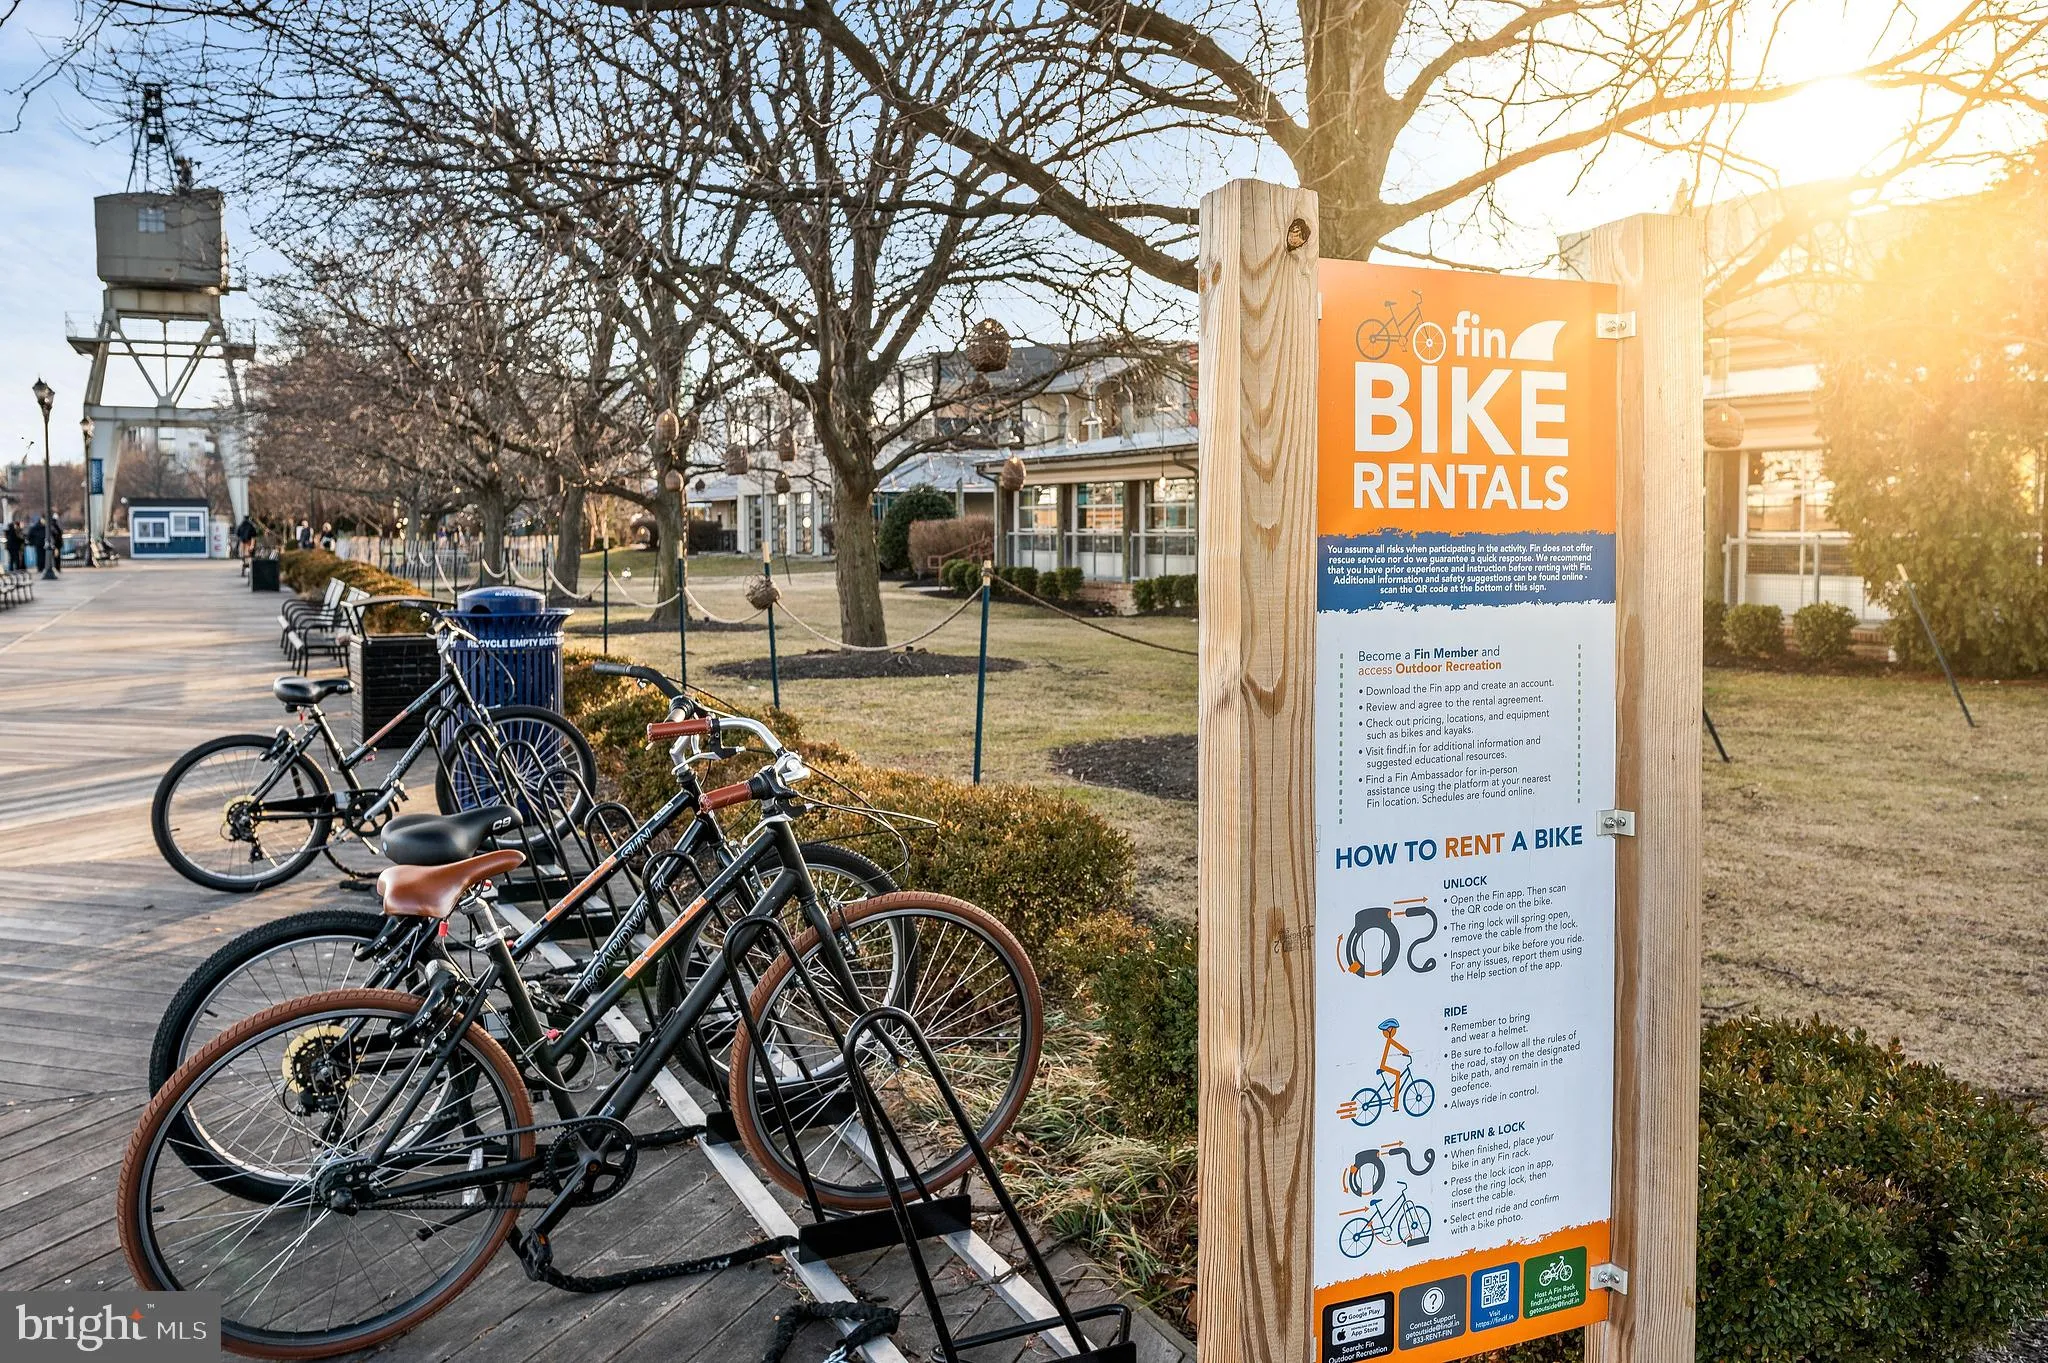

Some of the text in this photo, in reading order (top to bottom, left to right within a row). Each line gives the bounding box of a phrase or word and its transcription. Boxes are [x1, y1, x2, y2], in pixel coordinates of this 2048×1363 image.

[1452, 310, 1506, 358] fin
[1355, 361, 1568, 456] BIKE
[1353, 462, 1568, 511] RENTALS
[1327, 544, 1342, 553] You
[1375, 544, 1384, 552] all
[1386, 544, 1404, 552] risks
[1405, 544, 1427, 552] when
[1428, 543, 1475, 554] participating
[1477, 543, 1484, 552] in
[1485, 543, 1498, 552] the
[1500, 543, 1527, 554] activity.
[1529, 543, 1540, 552] Fin
[1542, 543, 1560, 551] does
[1561, 543, 1574, 551] not
[1575, 542, 1593, 551] offer
[1327, 561, 1592, 576] that you have prior experience and instruction before renting with Fin.
[1399, 584, 1412, 593] the
[1414, 584, 1427, 592] QR
[1429, 583, 1448, 592] code
[1450, 584, 1458, 592] at
[1459, 583, 1472, 592] the
[1474, 582, 1502, 591] bottom
[1504, 582, 1512, 591] of
[1514, 582, 1527, 590] this
[1529, 581, 1546, 592] sign.
[467, 640, 508, 648] RECYCLE
[510, 638, 538, 648] EMPTY
[1358, 652, 1401, 662] Become
[1414, 649, 1429, 659] Fin
[1433, 647, 1478, 658] Member
[1481, 646, 1499, 656] and
[1358, 660, 1501, 675] access Outdoor Recreation
[1366, 685, 1410, 696] Download
[1412, 684, 1426, 693] the
[1429, 683, 1442, 692] Fin
[1444, 685, 1460, 694] app
[1463, 681, 1478, 691] and
[1480, 681, 1506, 690] create
[1520, 678, 1554, 688] account.
[1366, 694, 1543, 712] Review and agree to the rental agreement.
[1365, 735, 1540, 756] Visit findf.in for additional information and
[1366, 774, 1551, 796] assistance using the platform at your nearest
[621, 828, 652, 858] SUN
[1335, 825, 1582, 868] HOW TO RENT A BIKE
[1443, 876, 1487, 889] UNLOCK
[1450, 885, 1566, 906] Open the Fin app. Then scan
[582, 874, 669, 993] BOARDWAK
[1450, 934, 1584, 960] Inspect your bike before you ride.
[1444, 1005, 1467, 1017] RIDE
[1450, 1013, 1530, 1032] Remember to bring
[1444, 1122, 1525, 1145] RETURN & LOCK
[1450, 1133, 1554, 1159] When finished, place your
[1450, 1194, 1559, 1224] Select end ride and confirm
[1450, 1223, 1468, 1235] with
[1477, 1218, 1494, 1229] bike
[1497, 1213, 1523, 1227] photo.
[1535, 1291, 1547, 1299] Host
[1348, 1312, 1367, 1320] Google
[1410, 1314, 1456, 1330] Contact Support
[1413, 1329, 1452, 1344] 833-RENT-FIN
[1328, 1346, 1387, 1363] Outdoor Recreation
[1342, 1343, 1364, 1353] Search:
